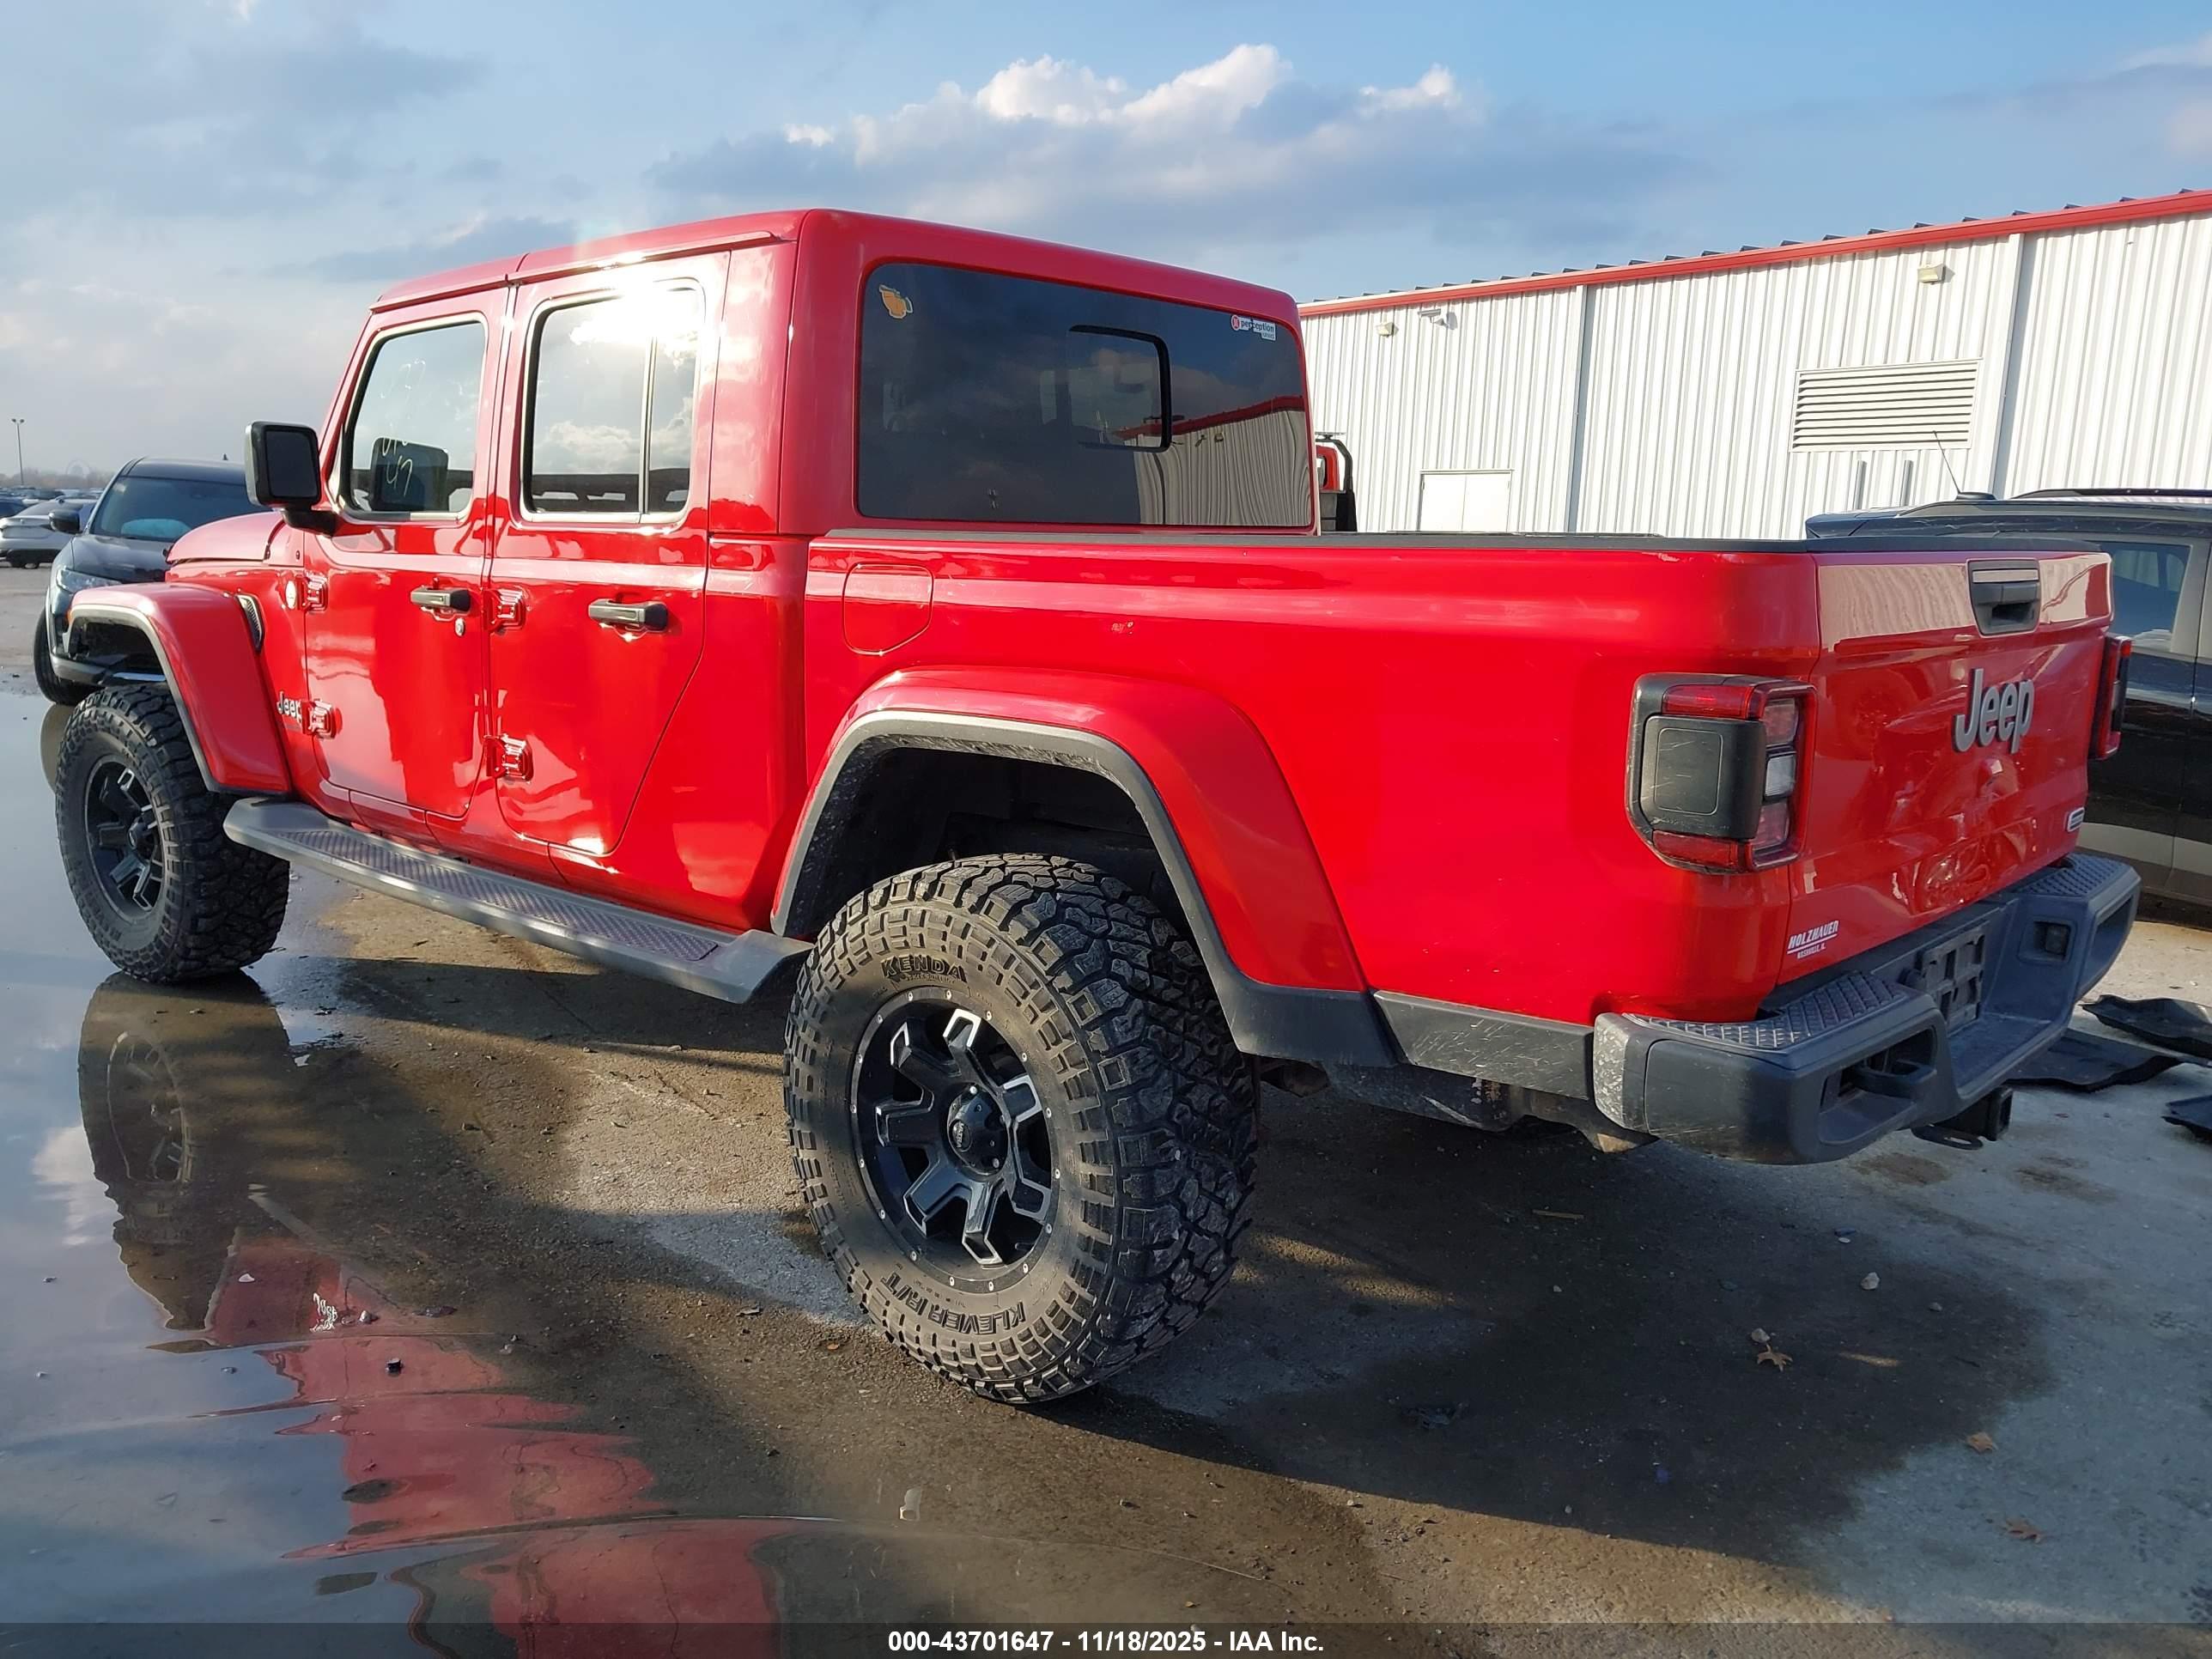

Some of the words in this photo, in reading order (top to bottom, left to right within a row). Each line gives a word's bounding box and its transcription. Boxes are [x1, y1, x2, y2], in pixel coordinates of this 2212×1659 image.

[1954, 668, 2035, 755] Jeep
[1788, 920, 1839, 950] HOLZHAUER
[881, 953, 968, 983] KENDA
[928, 1301, 1026, 1335] KLEVER
